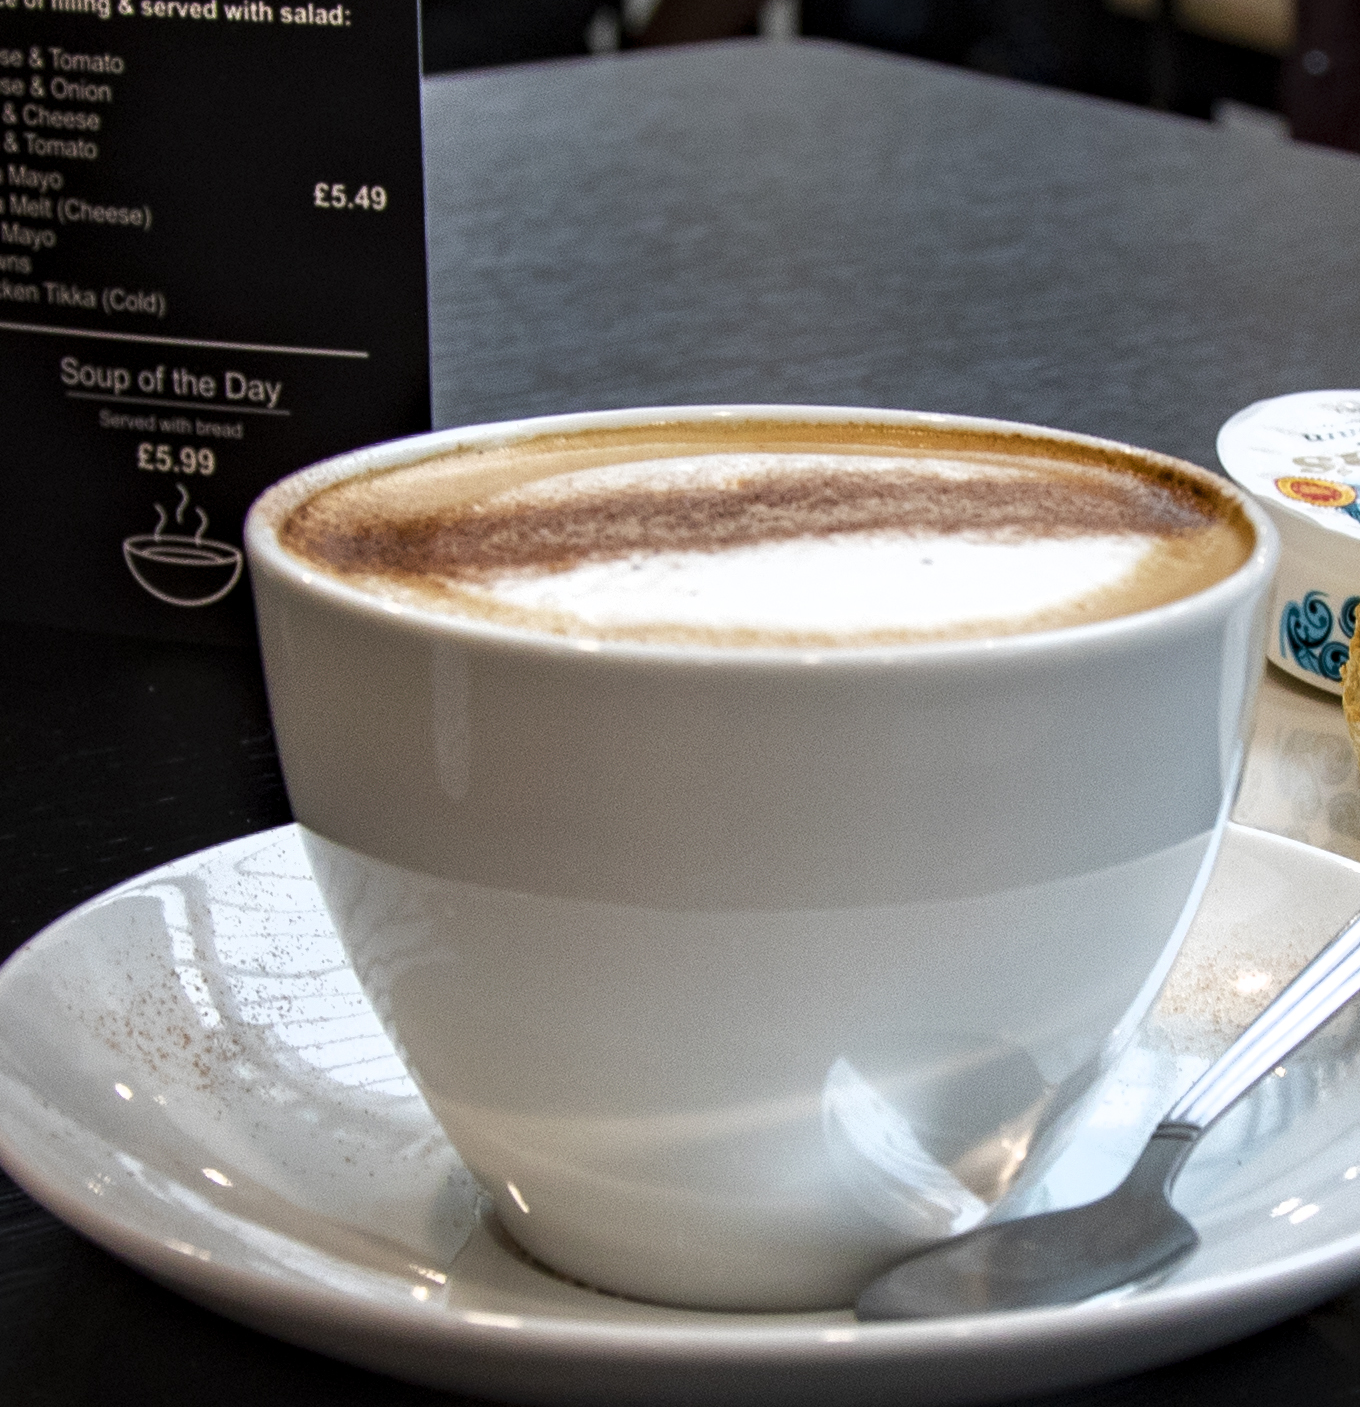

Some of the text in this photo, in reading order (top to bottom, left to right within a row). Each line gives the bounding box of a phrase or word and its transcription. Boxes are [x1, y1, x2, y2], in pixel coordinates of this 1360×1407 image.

[223, 0, 274, 22] with
[279, 3, 351, 26] salad:
[28, 46, 43, 68] &
[49, 46, 125, 74] Tomato
[313, 182, 388, 211] £5.49
[60, 355, 282, 409] Soup of the Day
[99, 409, 244, 440] Served with bread
[137, 442, 216, 476] £5.99
